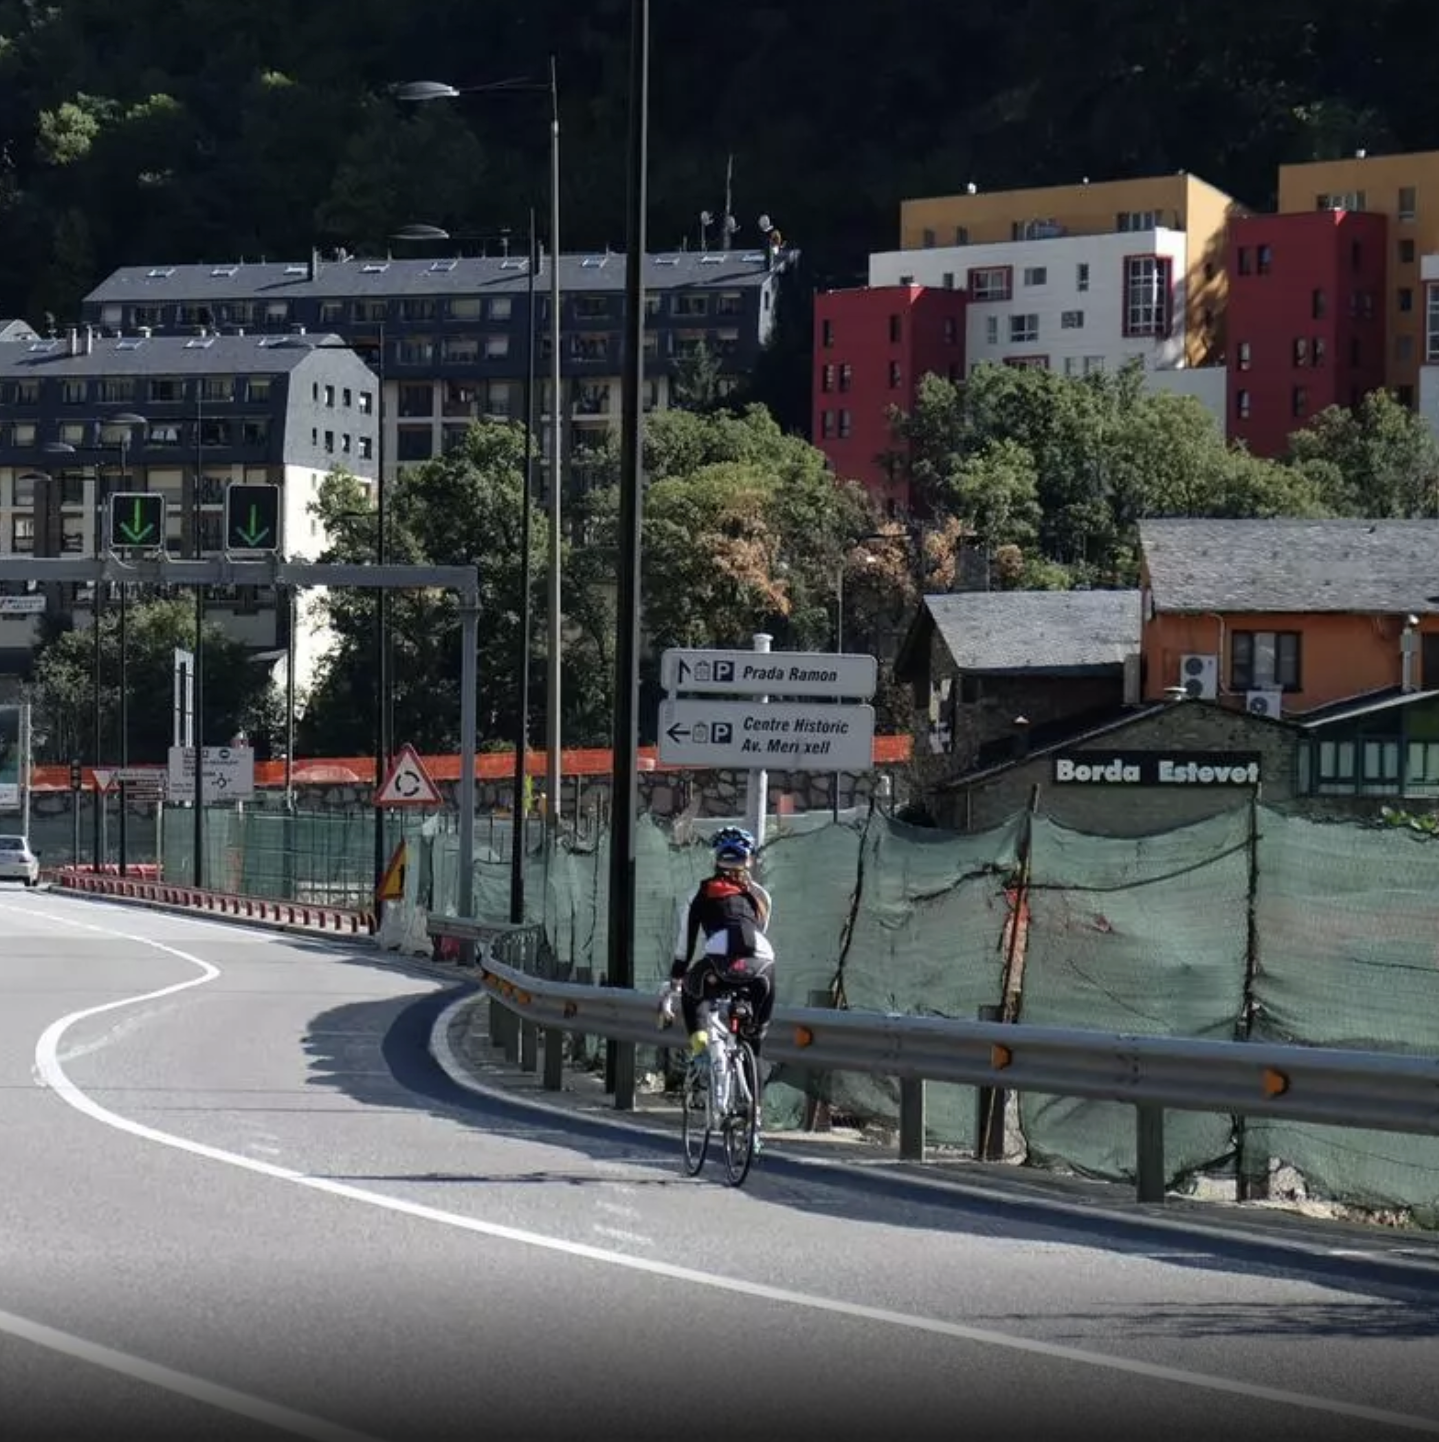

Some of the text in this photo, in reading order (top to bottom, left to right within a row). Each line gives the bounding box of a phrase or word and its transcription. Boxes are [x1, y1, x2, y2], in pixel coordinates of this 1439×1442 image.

[743, 665, 784, 681] Prada
[789, 667, 837, 682] Ramon
[743, 716, 790, 732] Centre
[740, 738, 831, 755] Av. Merixell
[1056, 758, 1260, 783] Borda Estevet
